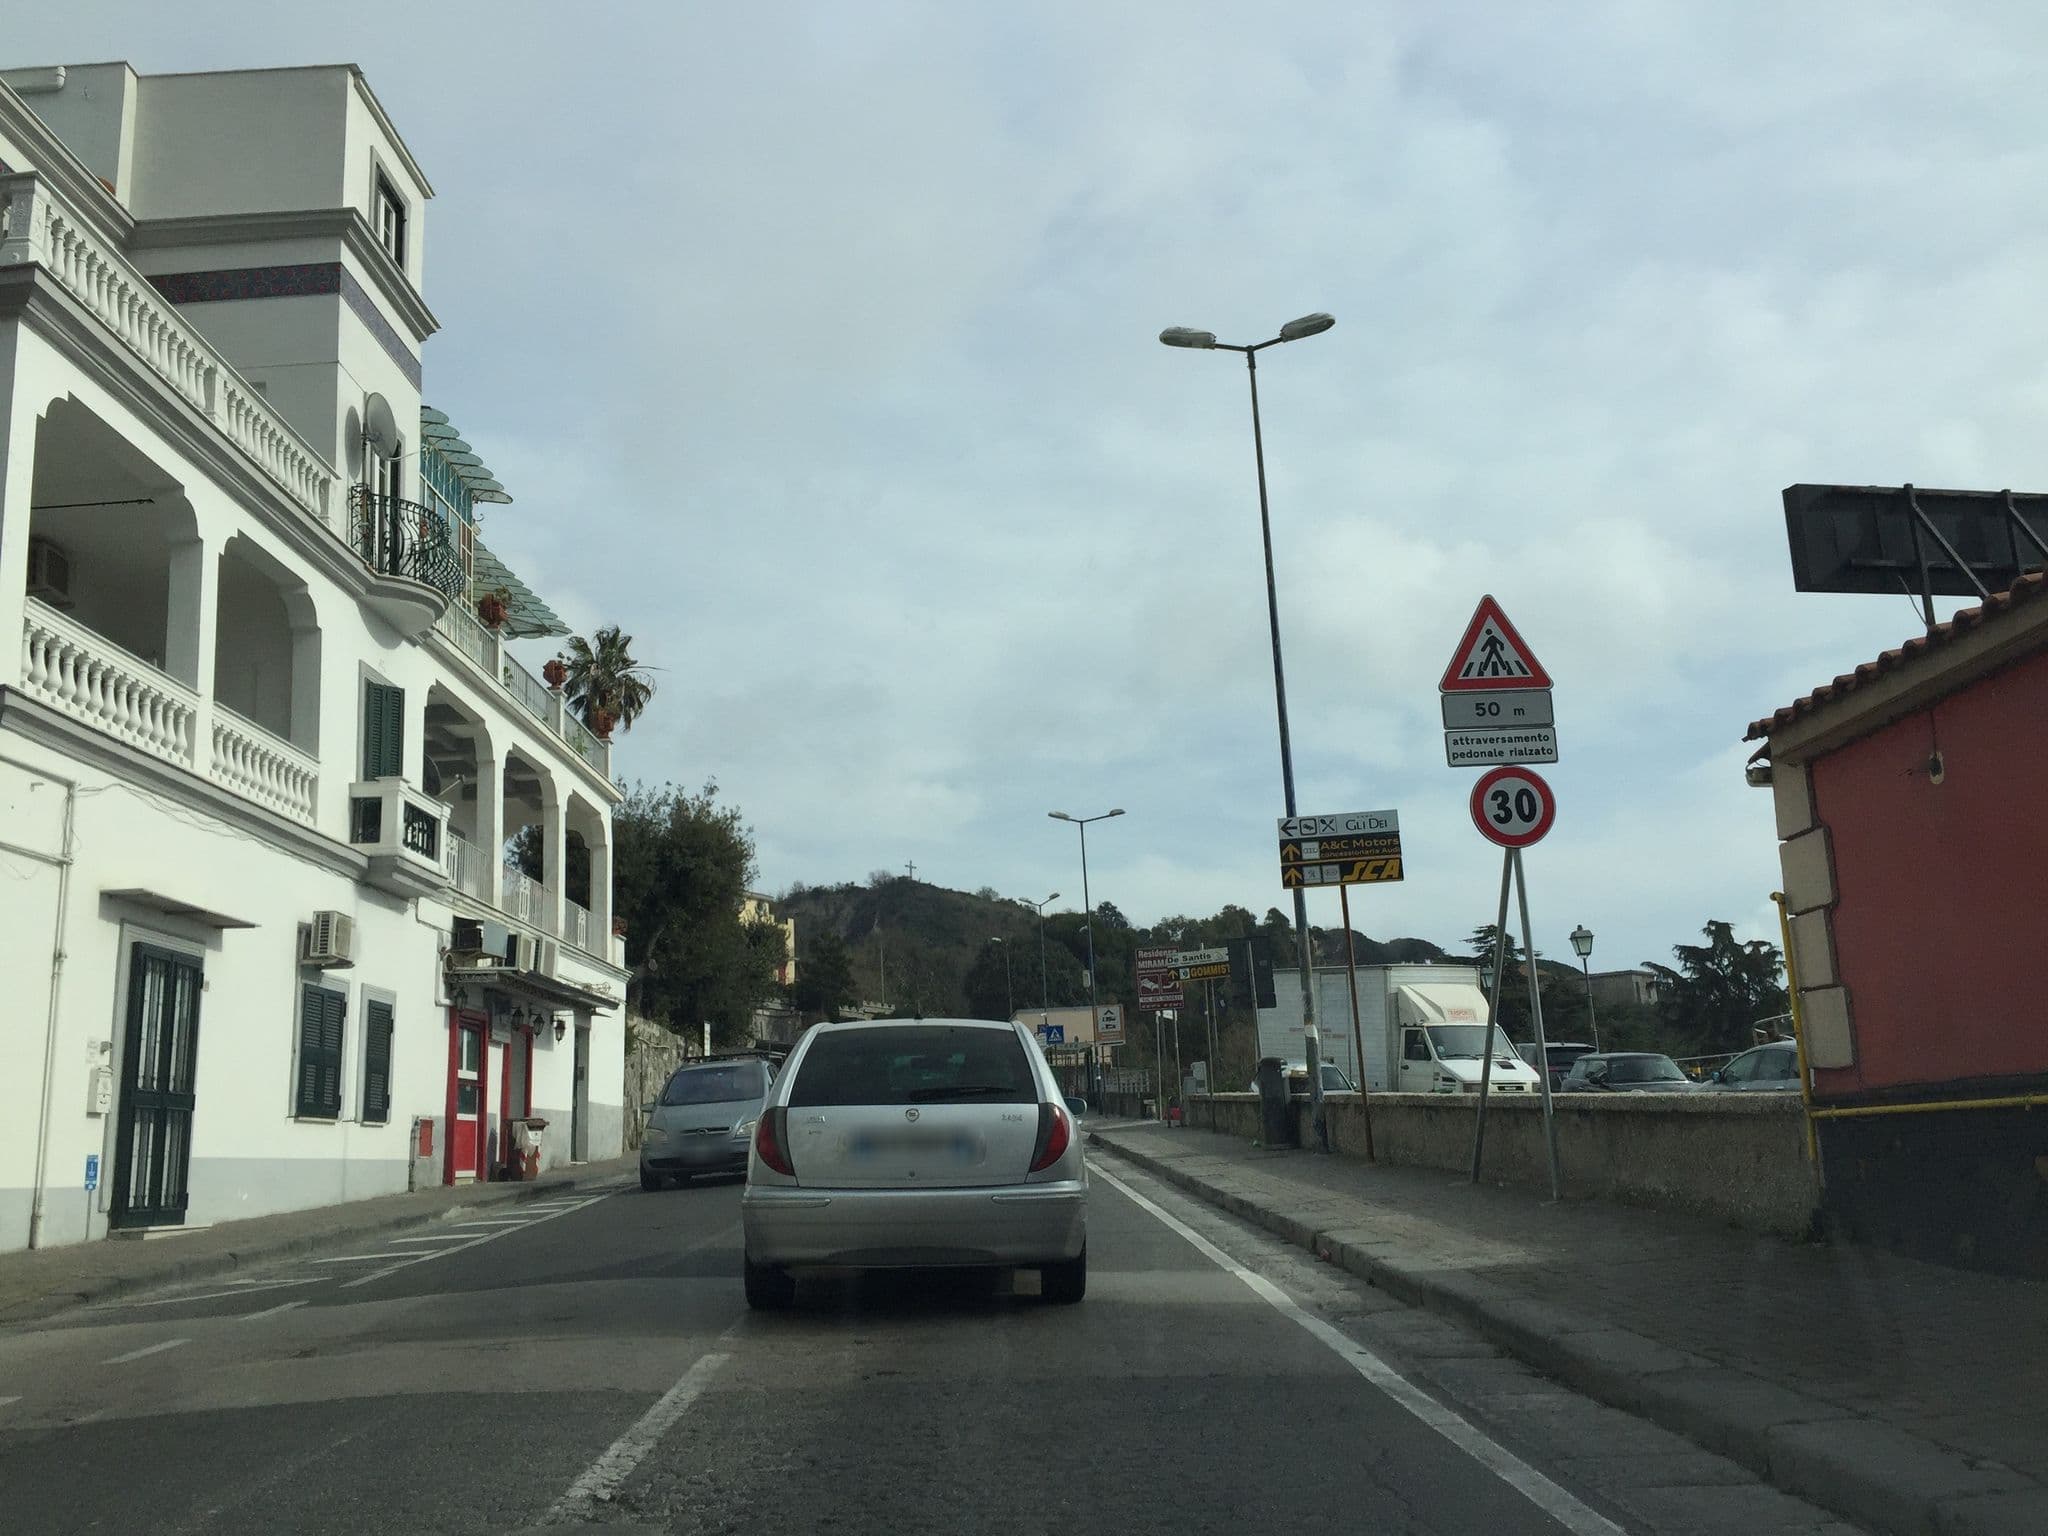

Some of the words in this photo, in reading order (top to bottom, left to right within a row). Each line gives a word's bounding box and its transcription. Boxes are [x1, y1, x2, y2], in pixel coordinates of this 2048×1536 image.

[1475, 702, 1500, 717] 50
[1513, 707, 1525, 716] m
[1452, 733, 1550, 746] attraversamento
[1452, 749, 1505, 760] pedonale
[1509, 746, 1553, 757] rialzato
[1490, 788, 1537, 824] 30
[1320, 839, 1349, 850] A&C
[1352, 838, 1399, 847] Motors
[1342, 858, 1400, 882] SCA
[1167, 956, 1179, 964] De
[1182, 952, 1212, 961] Santis
